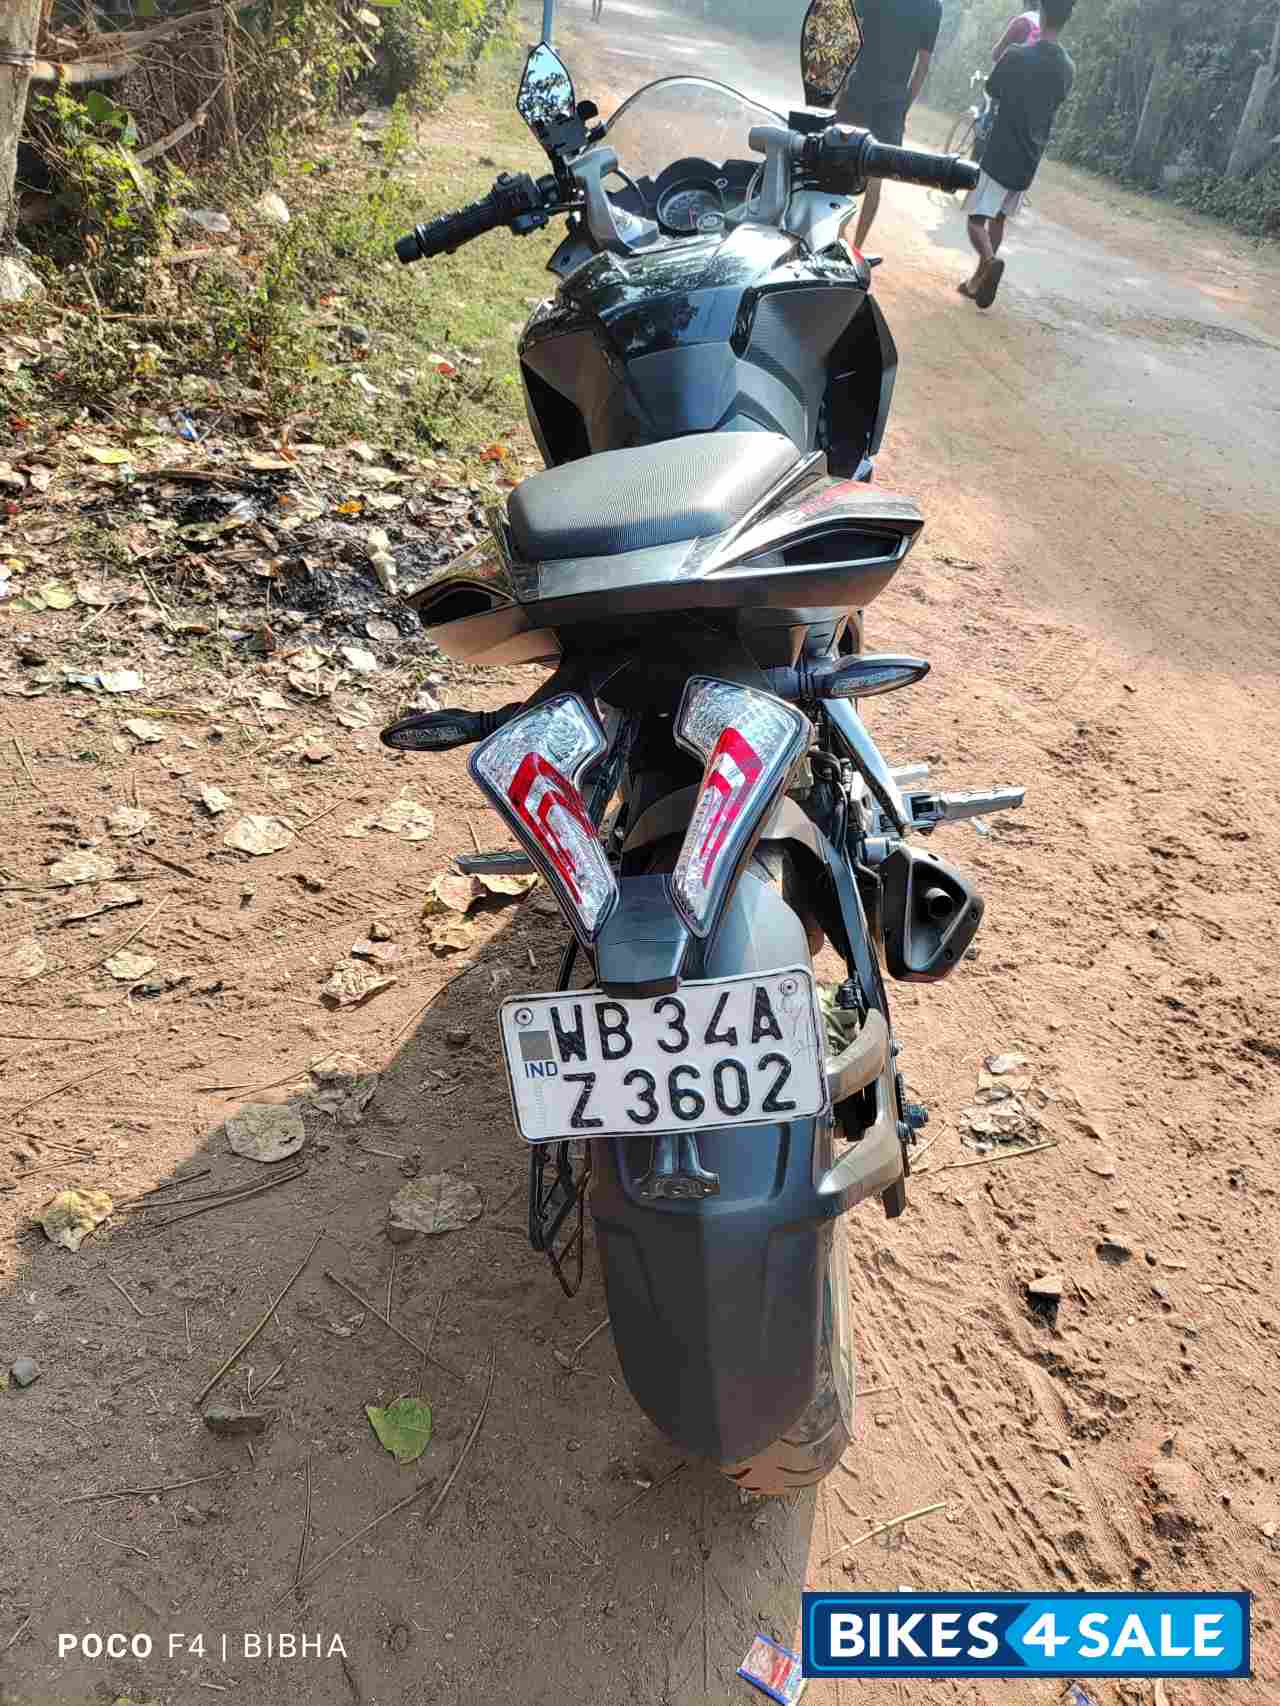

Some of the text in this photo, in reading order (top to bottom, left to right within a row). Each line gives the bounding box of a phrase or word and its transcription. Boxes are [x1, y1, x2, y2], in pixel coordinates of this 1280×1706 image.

[550, 986, 784, 1062] WB 34A
[524, 1061, 558, 1078] IND
